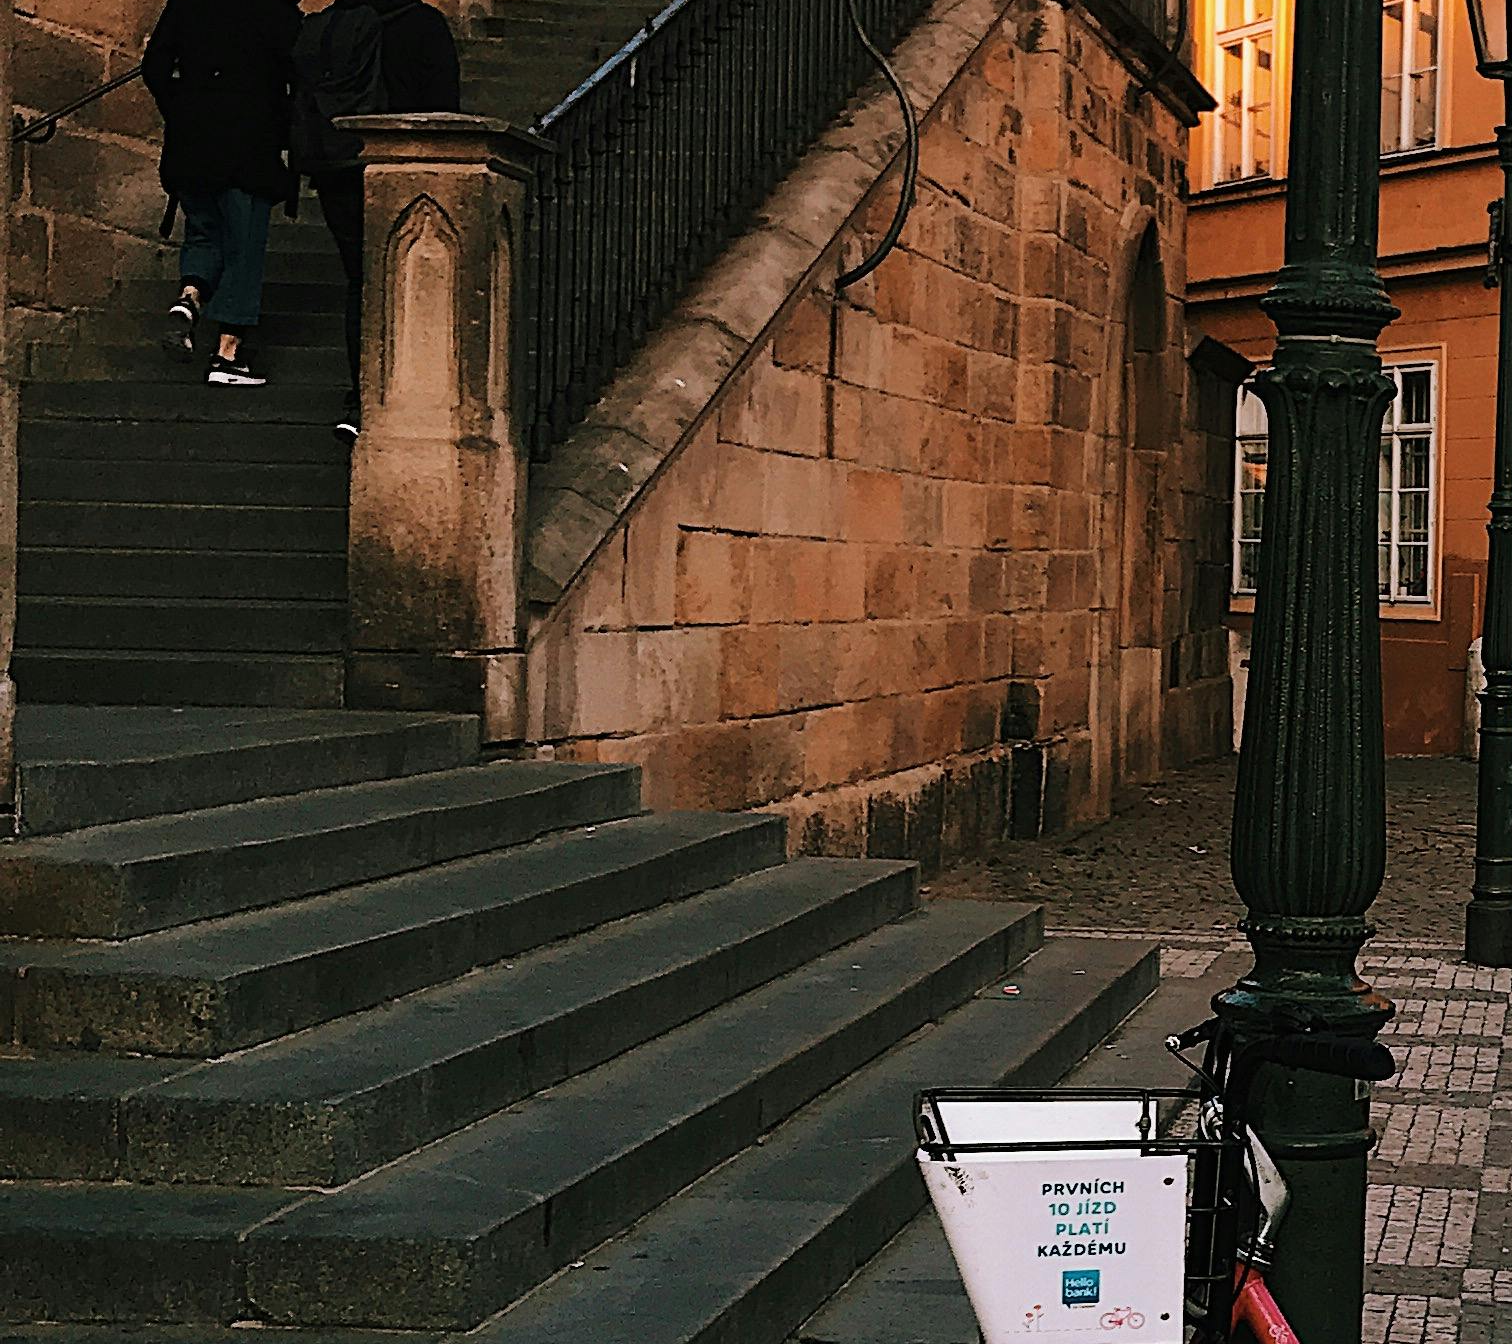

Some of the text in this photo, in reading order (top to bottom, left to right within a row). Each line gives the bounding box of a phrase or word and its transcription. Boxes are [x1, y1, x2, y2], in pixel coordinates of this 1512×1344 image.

[1042, 1178, 1125, 1196] PRVNÍCH
[1048, 1198, 1117, 1216] 10 JÍZD
[1056, 1218, 1110, 1236] PLATÍ
[1037, 1239, 1126, 1257] KAŽDÉMU
[1065, 1277, 1094, 1287] Hello
[1065, 1287, 1097, 1297] bank!
